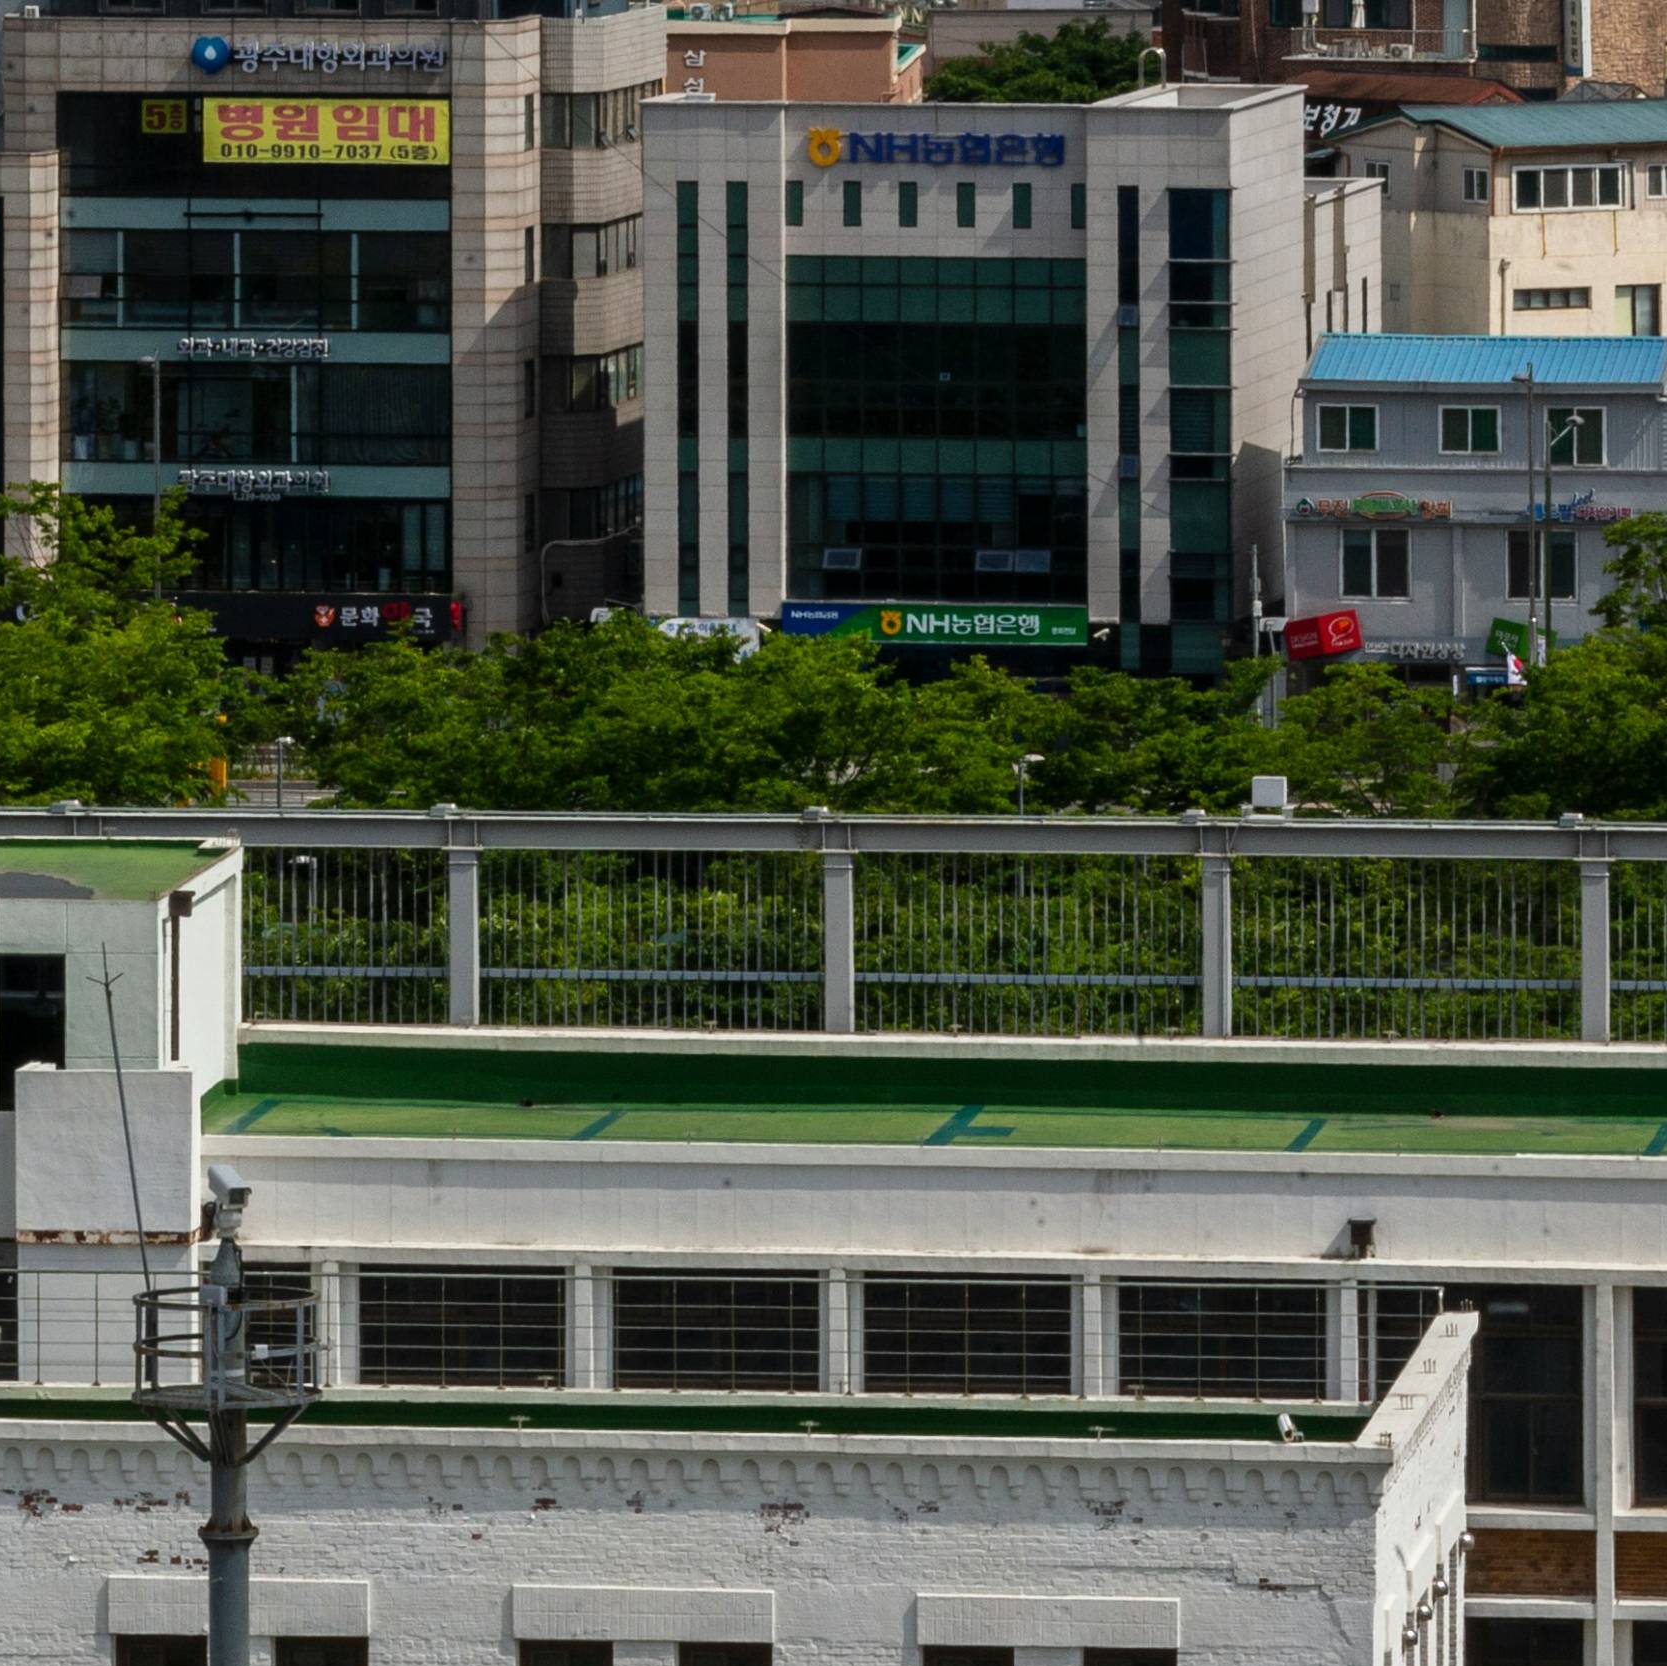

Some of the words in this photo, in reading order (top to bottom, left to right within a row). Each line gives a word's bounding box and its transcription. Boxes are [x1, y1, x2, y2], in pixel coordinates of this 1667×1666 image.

[144, 103, 184, 132] 5층
[219, 143, 381, 160] 010-9910-7037
[388, 145, 439, 163] (5층)
[848, 132, 1065, 167] NH농협은행
[906, 612, 1040, 636] NH농협은행
